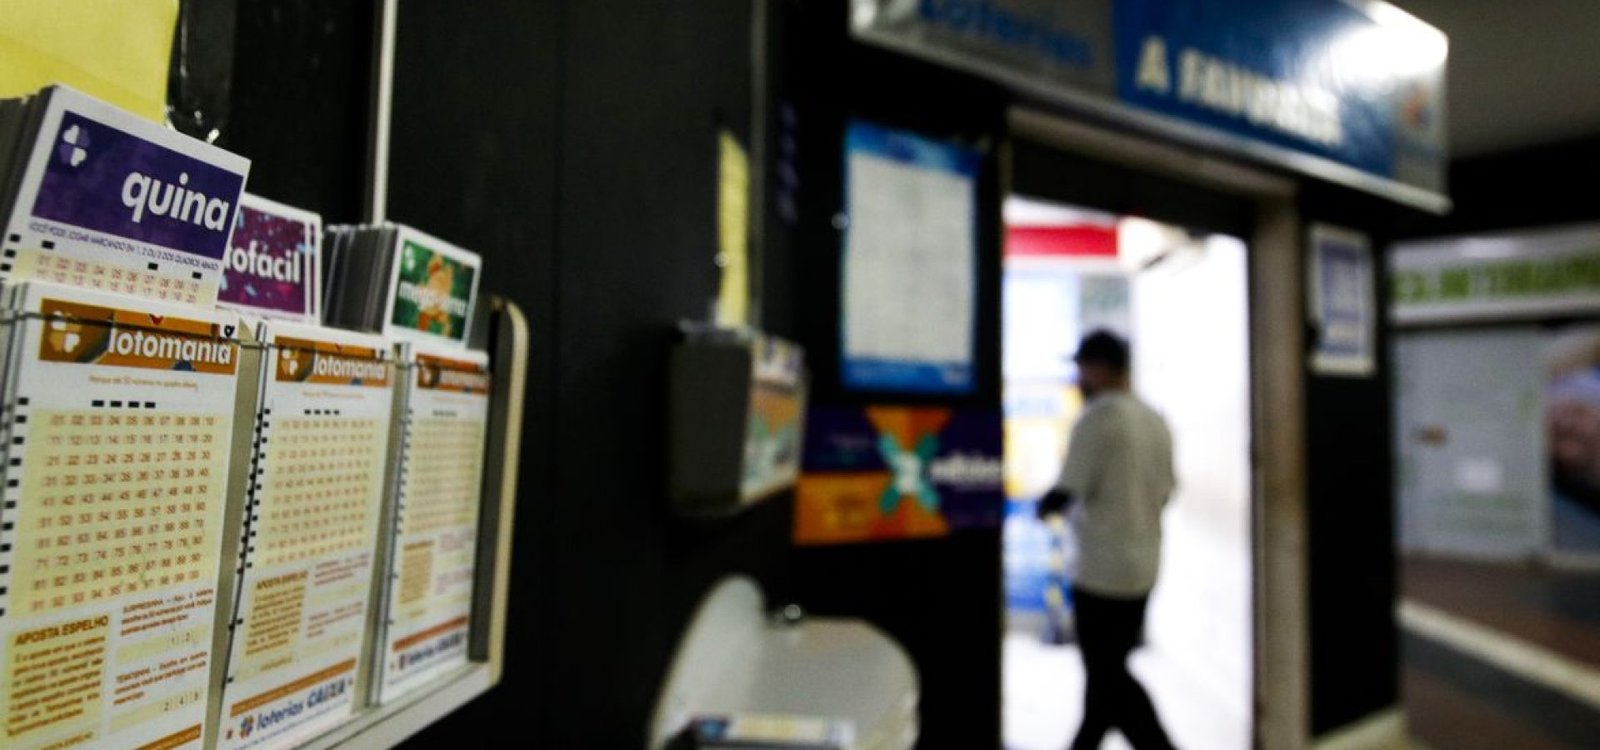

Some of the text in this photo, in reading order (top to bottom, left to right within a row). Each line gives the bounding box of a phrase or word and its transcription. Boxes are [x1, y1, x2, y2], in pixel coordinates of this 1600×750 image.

[121, 172, 229, 231] quina
[109, 328, 231, 365] lotomania
[313, 355, 386, 379] lotomania
[15, 628, 59, 645] APOSTA
[62, 615, 109, 635] ESPELHO
